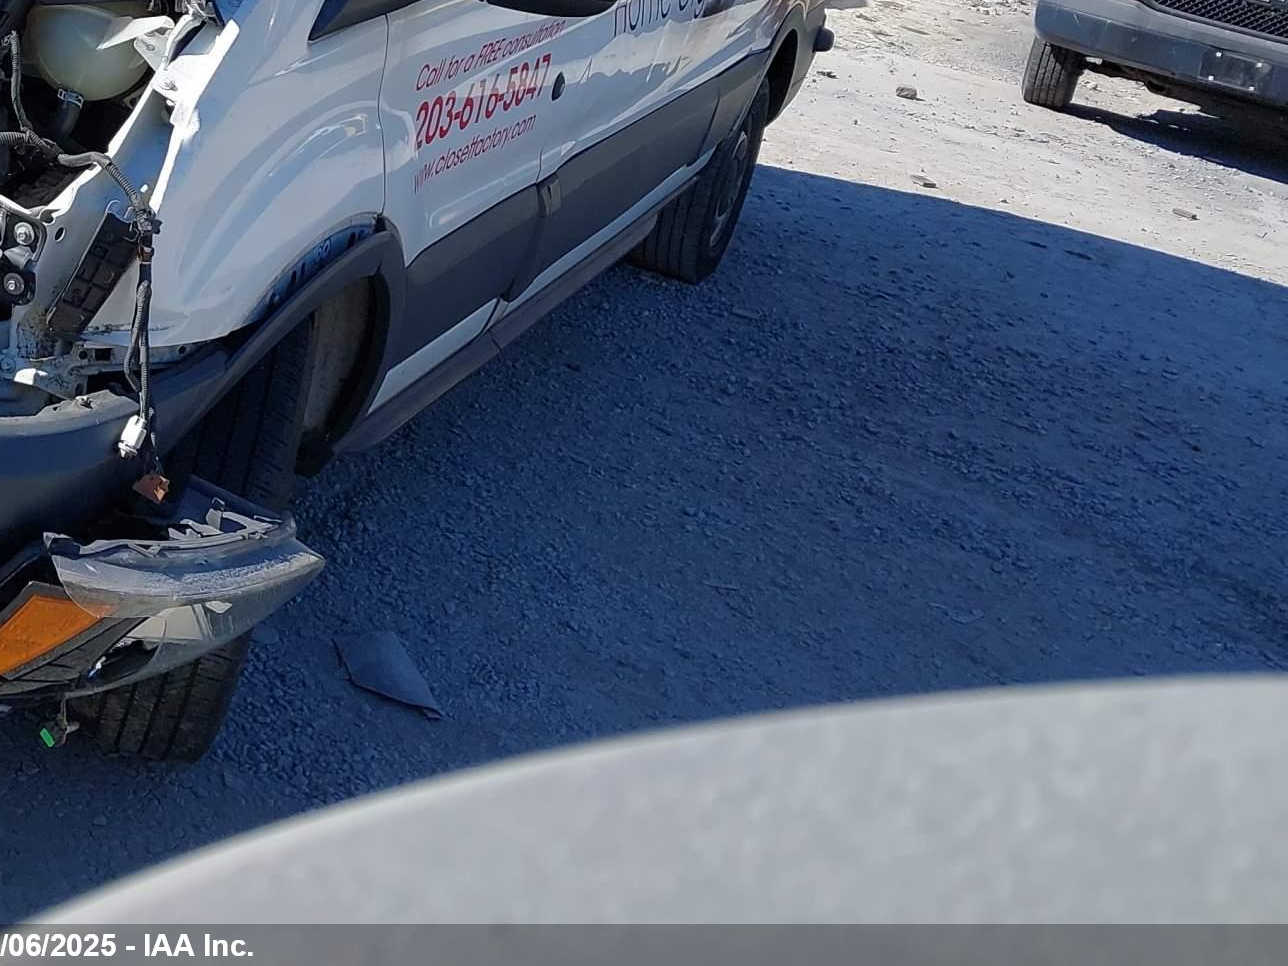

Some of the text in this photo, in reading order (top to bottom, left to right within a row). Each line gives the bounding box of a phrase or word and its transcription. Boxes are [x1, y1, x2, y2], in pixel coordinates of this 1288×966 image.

[416, 19, 567, 92] Call for a FREE consultation
[415, 52, 552, 150] 203-616-5847
